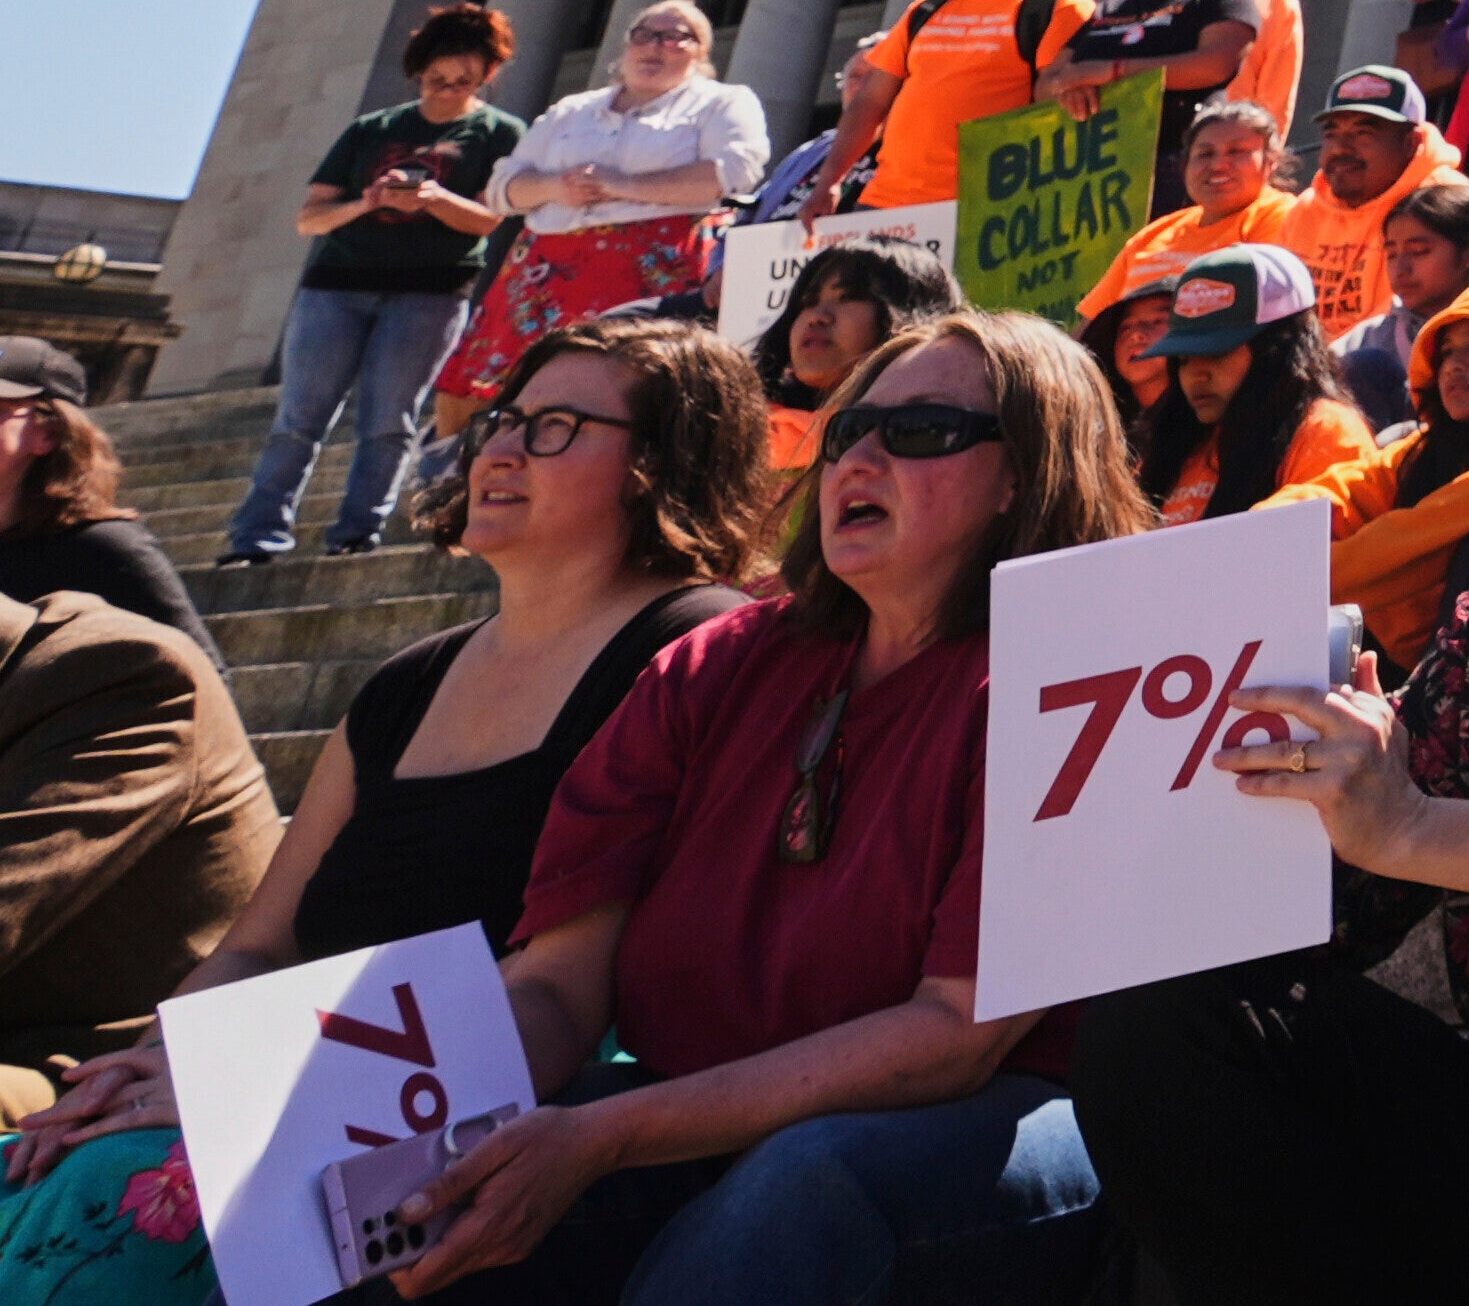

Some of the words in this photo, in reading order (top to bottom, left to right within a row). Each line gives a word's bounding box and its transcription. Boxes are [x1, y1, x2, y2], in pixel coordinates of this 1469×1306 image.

[986, 109, 1120, 202] BLUE
[977, 169, 1132, 272] COLLAR
[1016, 250, 1082, 295] NOT
[1033, 638, 1293, 824] 7%
